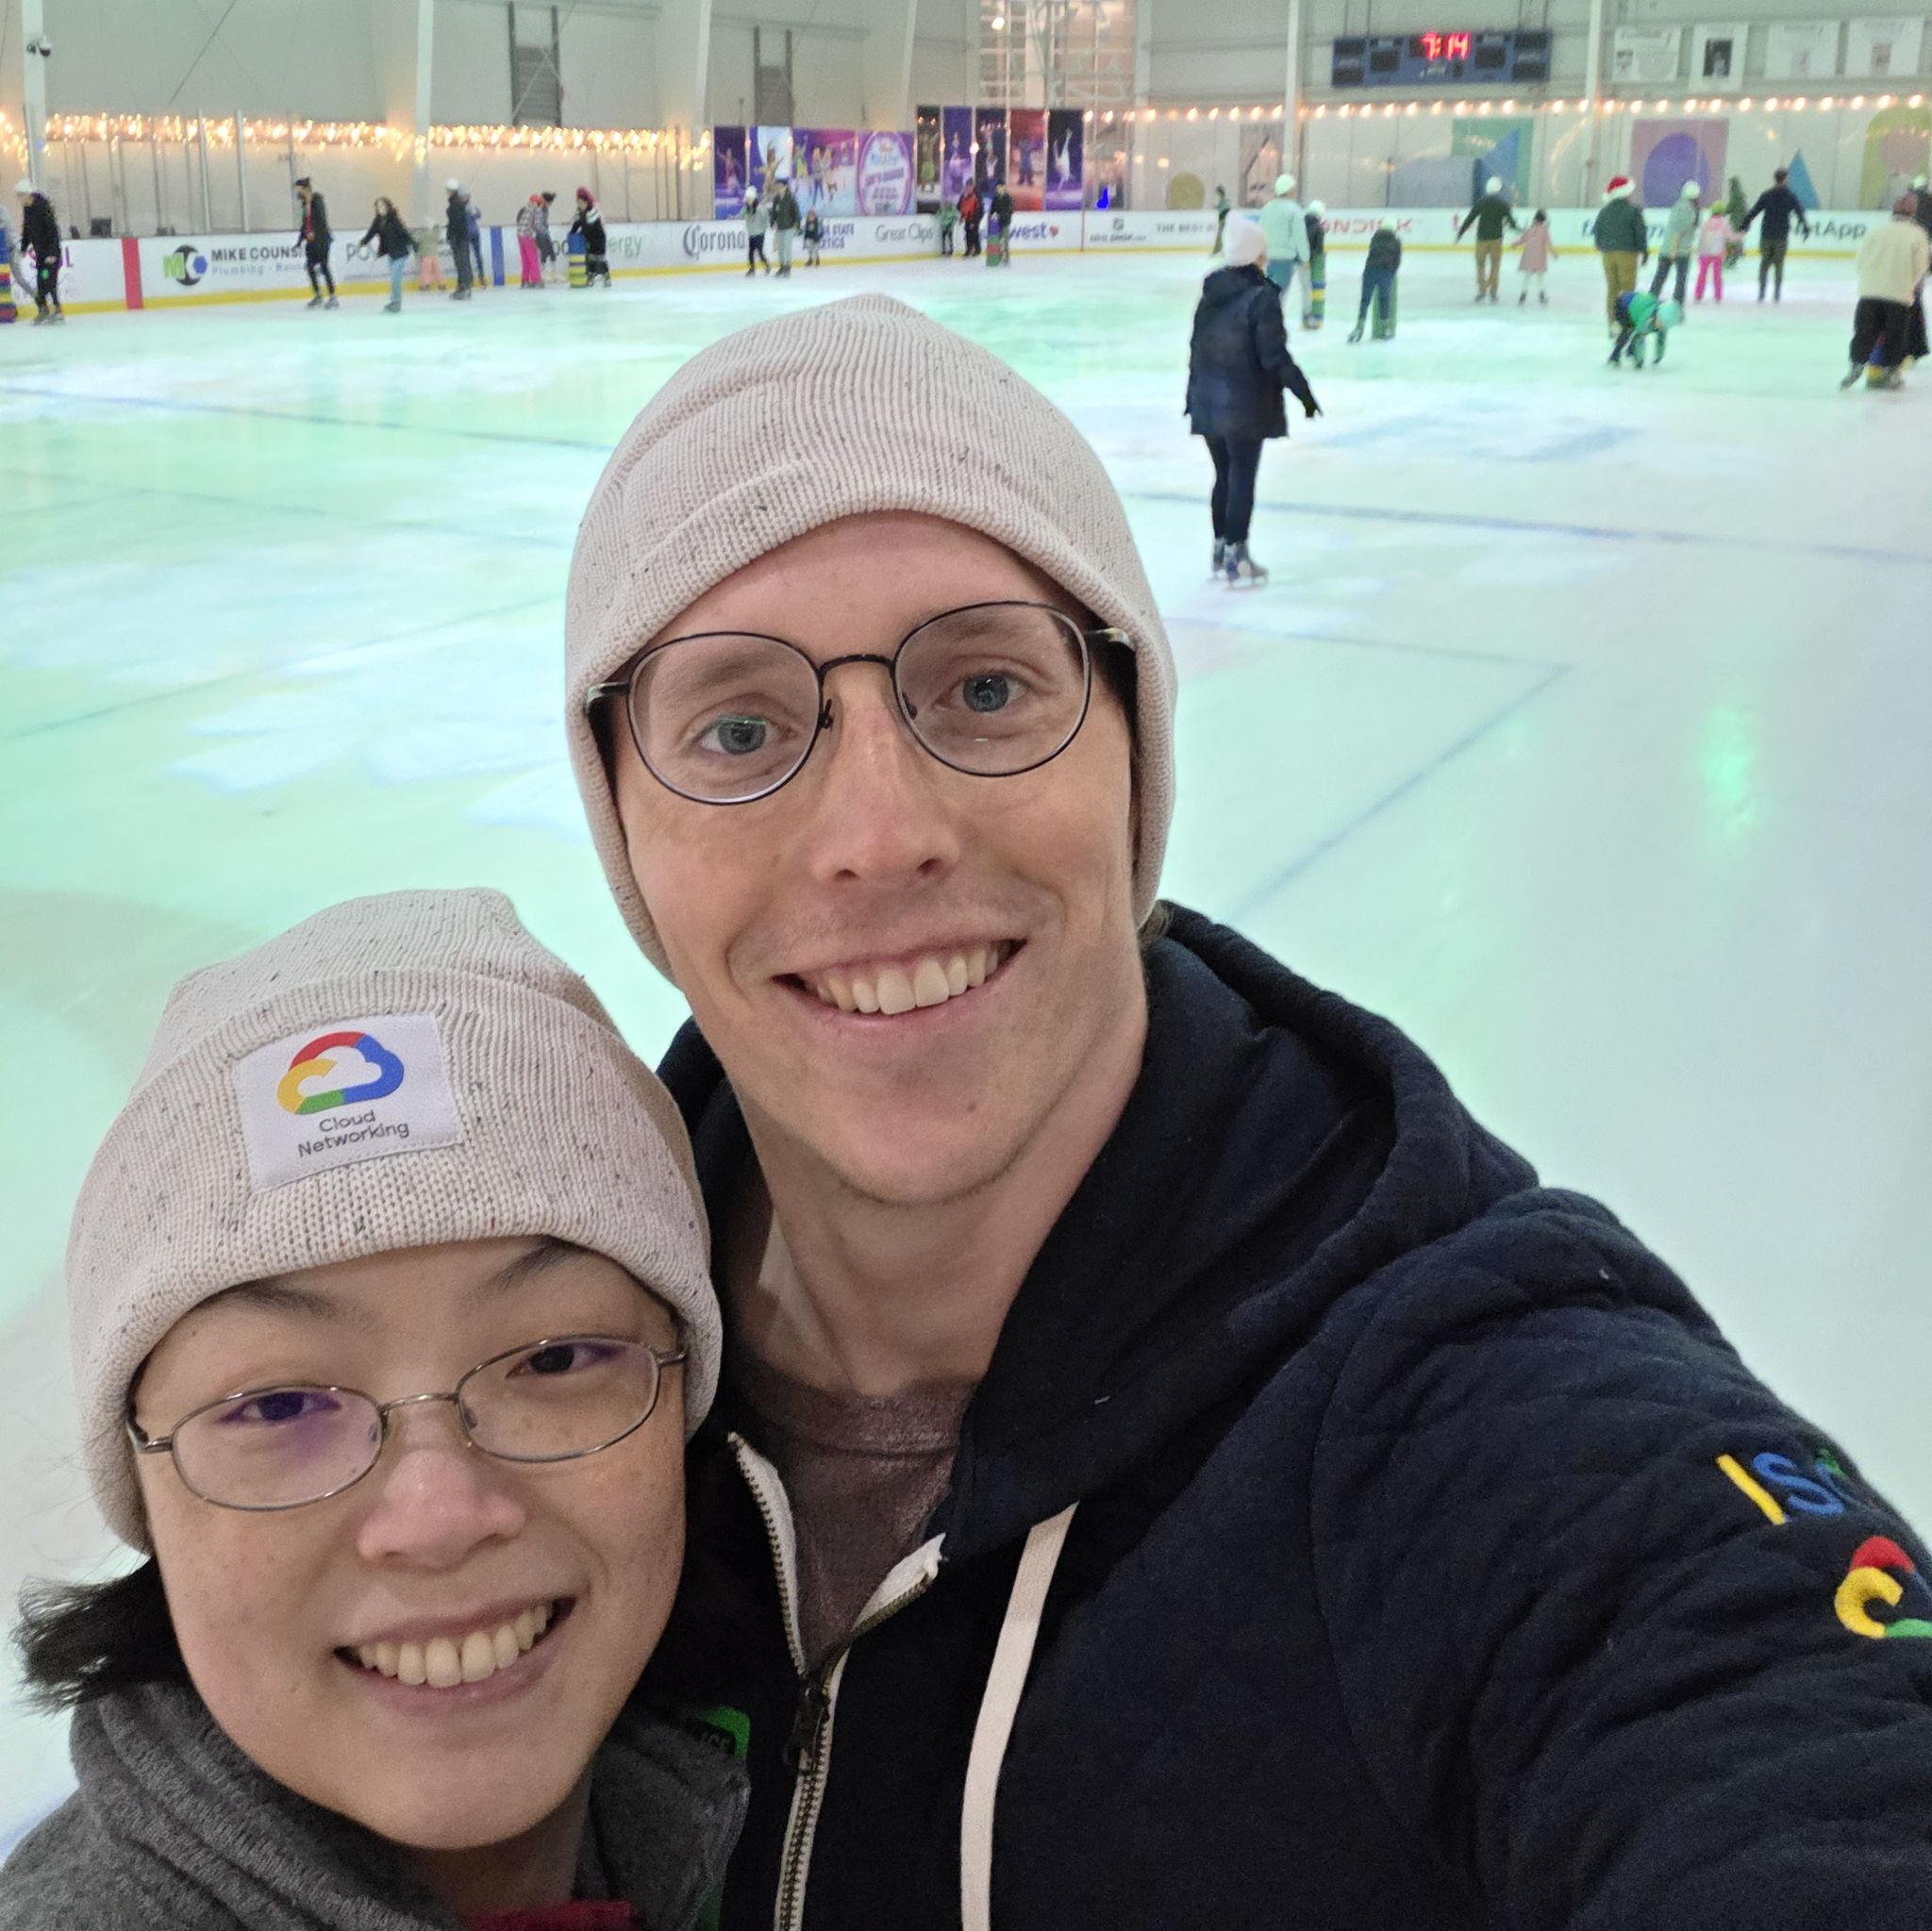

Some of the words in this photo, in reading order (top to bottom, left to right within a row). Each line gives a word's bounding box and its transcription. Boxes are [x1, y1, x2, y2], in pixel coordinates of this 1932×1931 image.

[1421, 32, 1471, 60] 7:14
[211, 248, 246, 261] MIKE
[608, 236, 643, 258] ergy
[683, 225, 745, 260] Corona
[319, 1110, 376, 1132] Cloud
[298, 1122, 409, 1157] Networking
